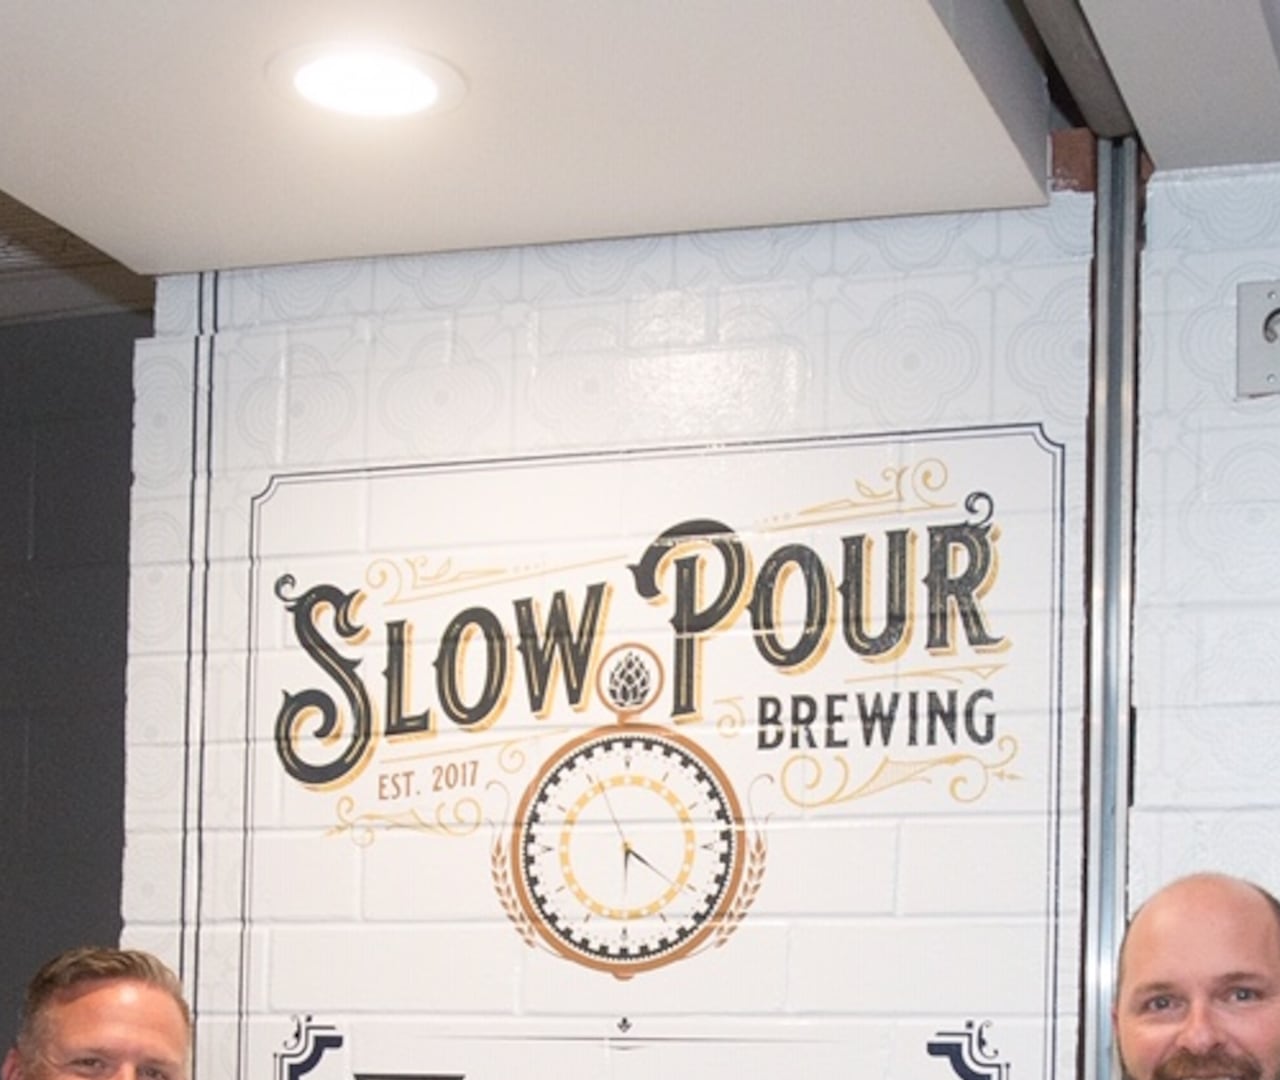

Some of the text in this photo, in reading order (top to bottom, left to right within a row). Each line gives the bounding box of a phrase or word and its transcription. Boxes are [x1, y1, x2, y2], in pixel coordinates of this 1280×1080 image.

[274, 492, 1012, 791] SLOW POUR
[757, 688, 997, 751] BREWING
[378, 760, 479, 800] EST. 2017
